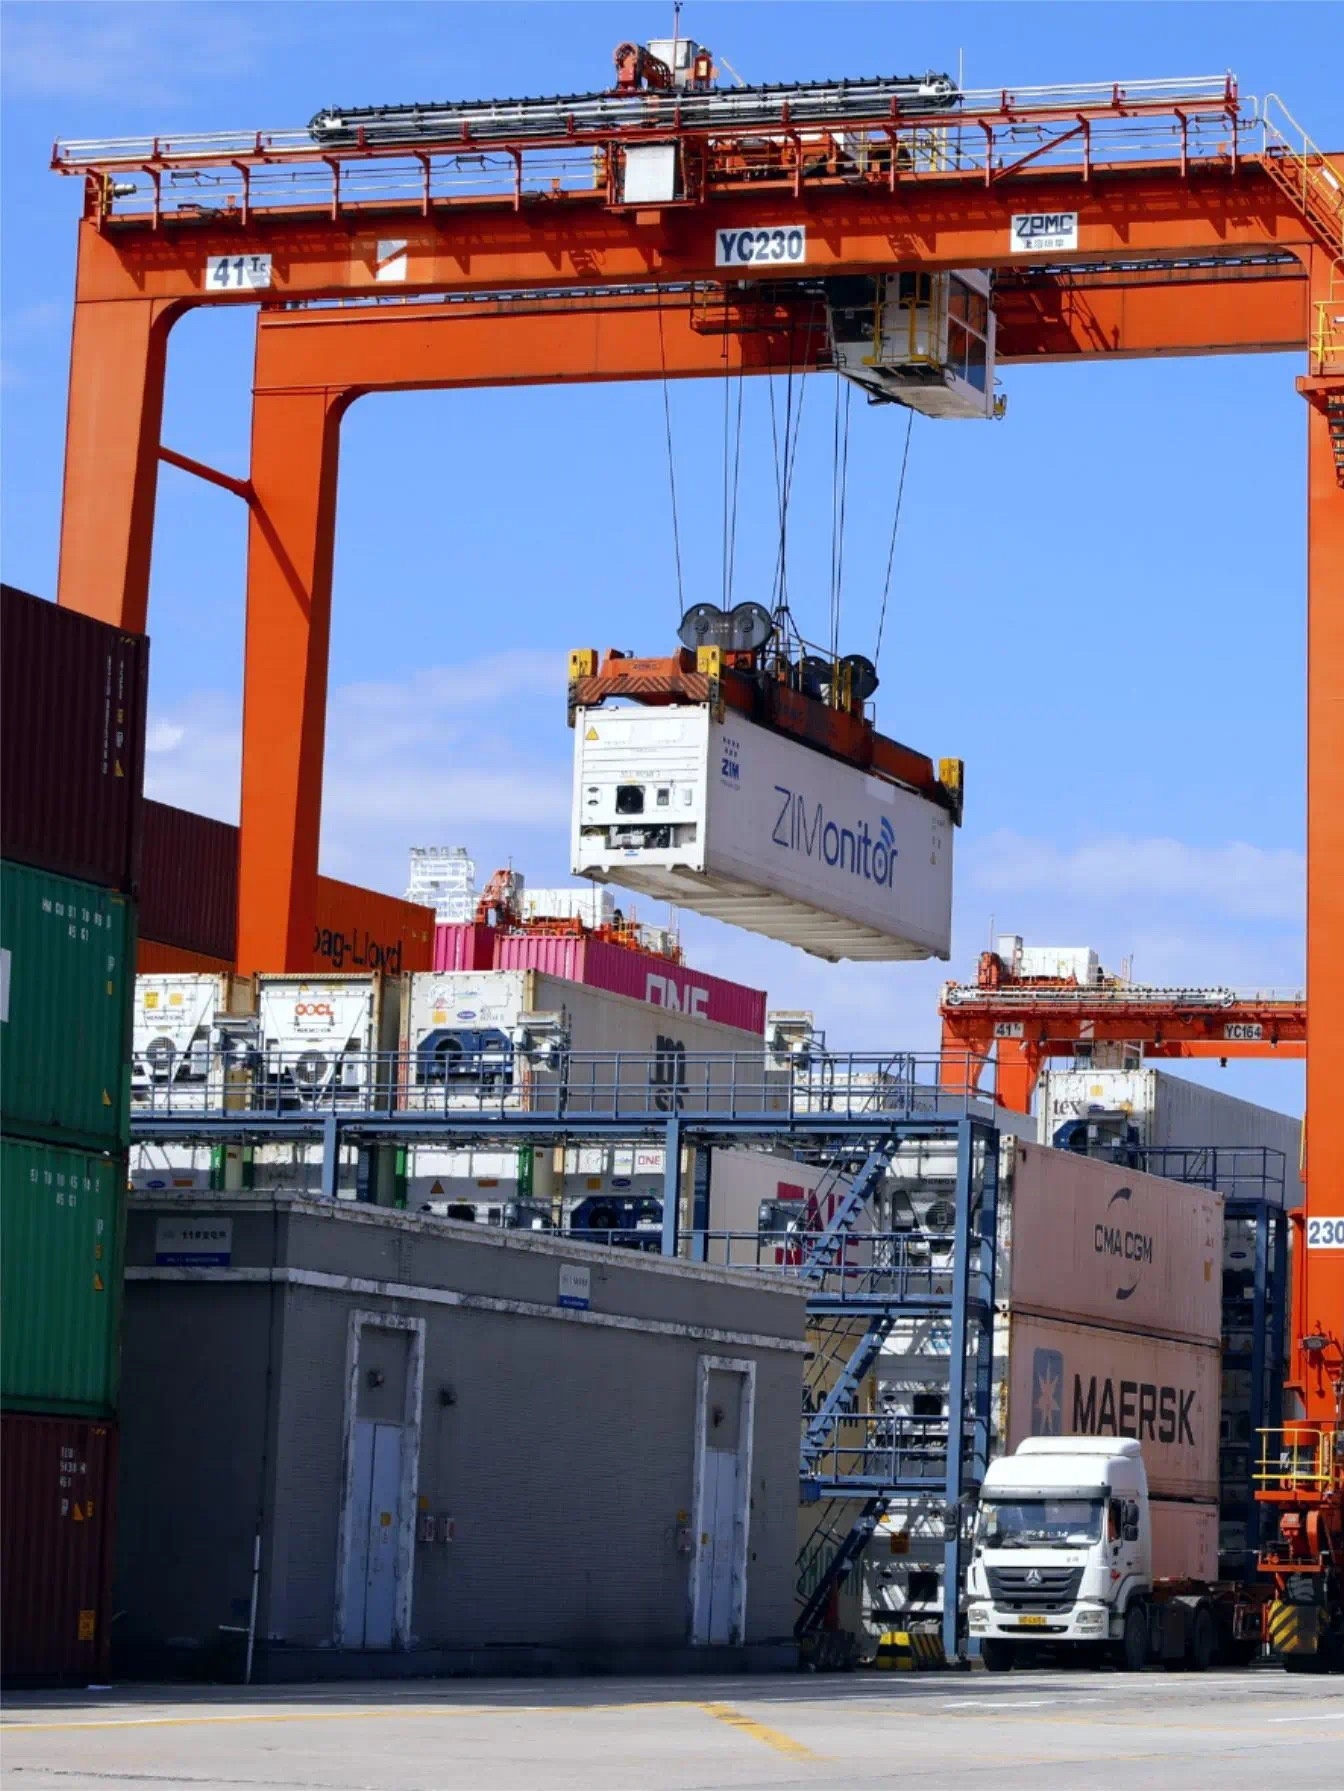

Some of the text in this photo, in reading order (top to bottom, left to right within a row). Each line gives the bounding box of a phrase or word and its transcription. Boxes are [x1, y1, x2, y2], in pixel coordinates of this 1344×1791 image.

[1016, 215, 1073, 237] ZPMC
[720, 229, 804, 264] YC230
[721, 758, 740, 780] ZIM
[771, 786, 898, 888] ZIMonitor
[295, 1003, 334, 1016] OOCL
[646, 974, 709, 1019] ONE
[638, 1155, 660, 1165] ONE
[1094, 1224, 1153, 1264] CMA CGM
[1073, 1373, 1196, 1446] MAERSK
